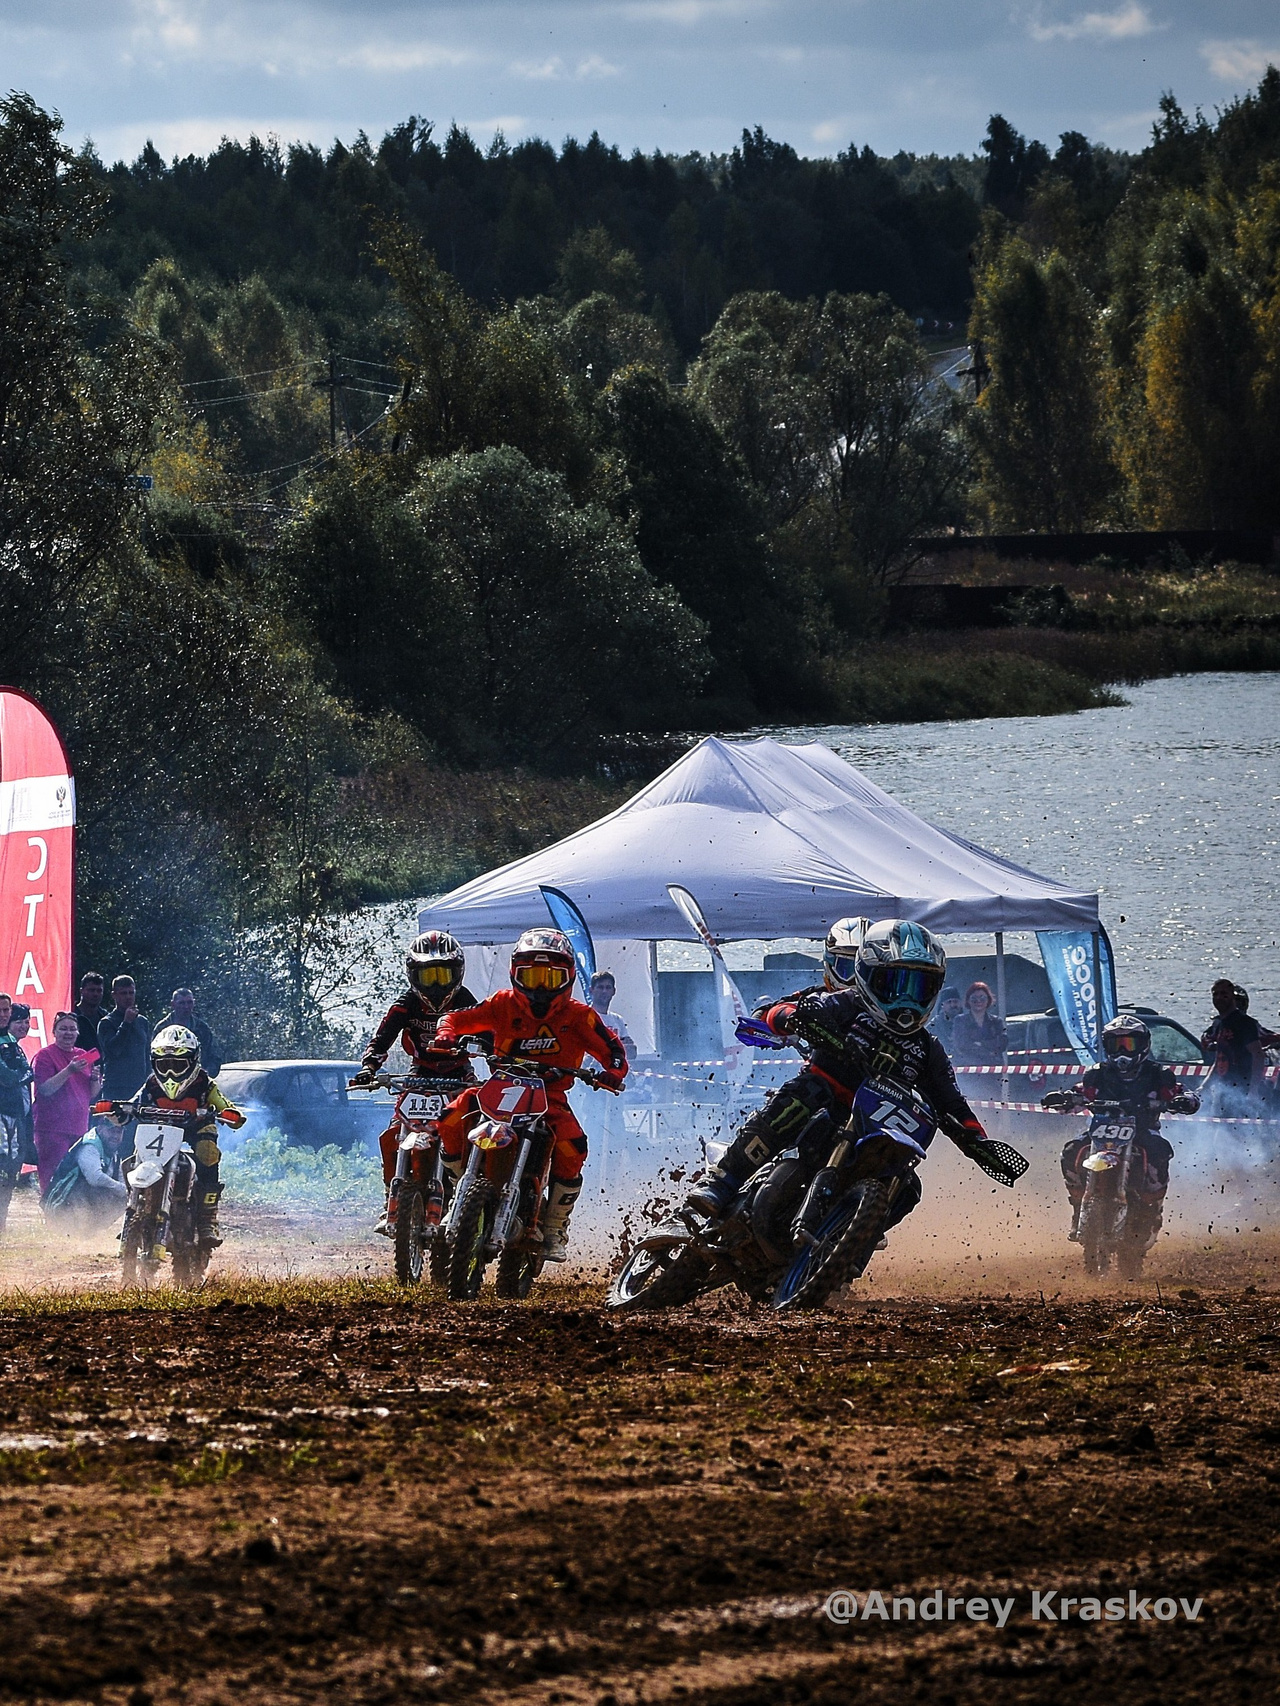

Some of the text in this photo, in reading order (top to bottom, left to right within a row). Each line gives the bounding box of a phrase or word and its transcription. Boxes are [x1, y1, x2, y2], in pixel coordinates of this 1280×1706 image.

[520, 1037, 556, 1050] LEATT
[497, 1085, 526, 1113] 1
[877, 1082, 903, 1101] YAMAHA
[408, 1098, 440, 1112] 113
[869, 1100, 920, 1133] 12
[1092, 1124, 1134, 1140] 430
[146, 1134, 164, 1157] 4
